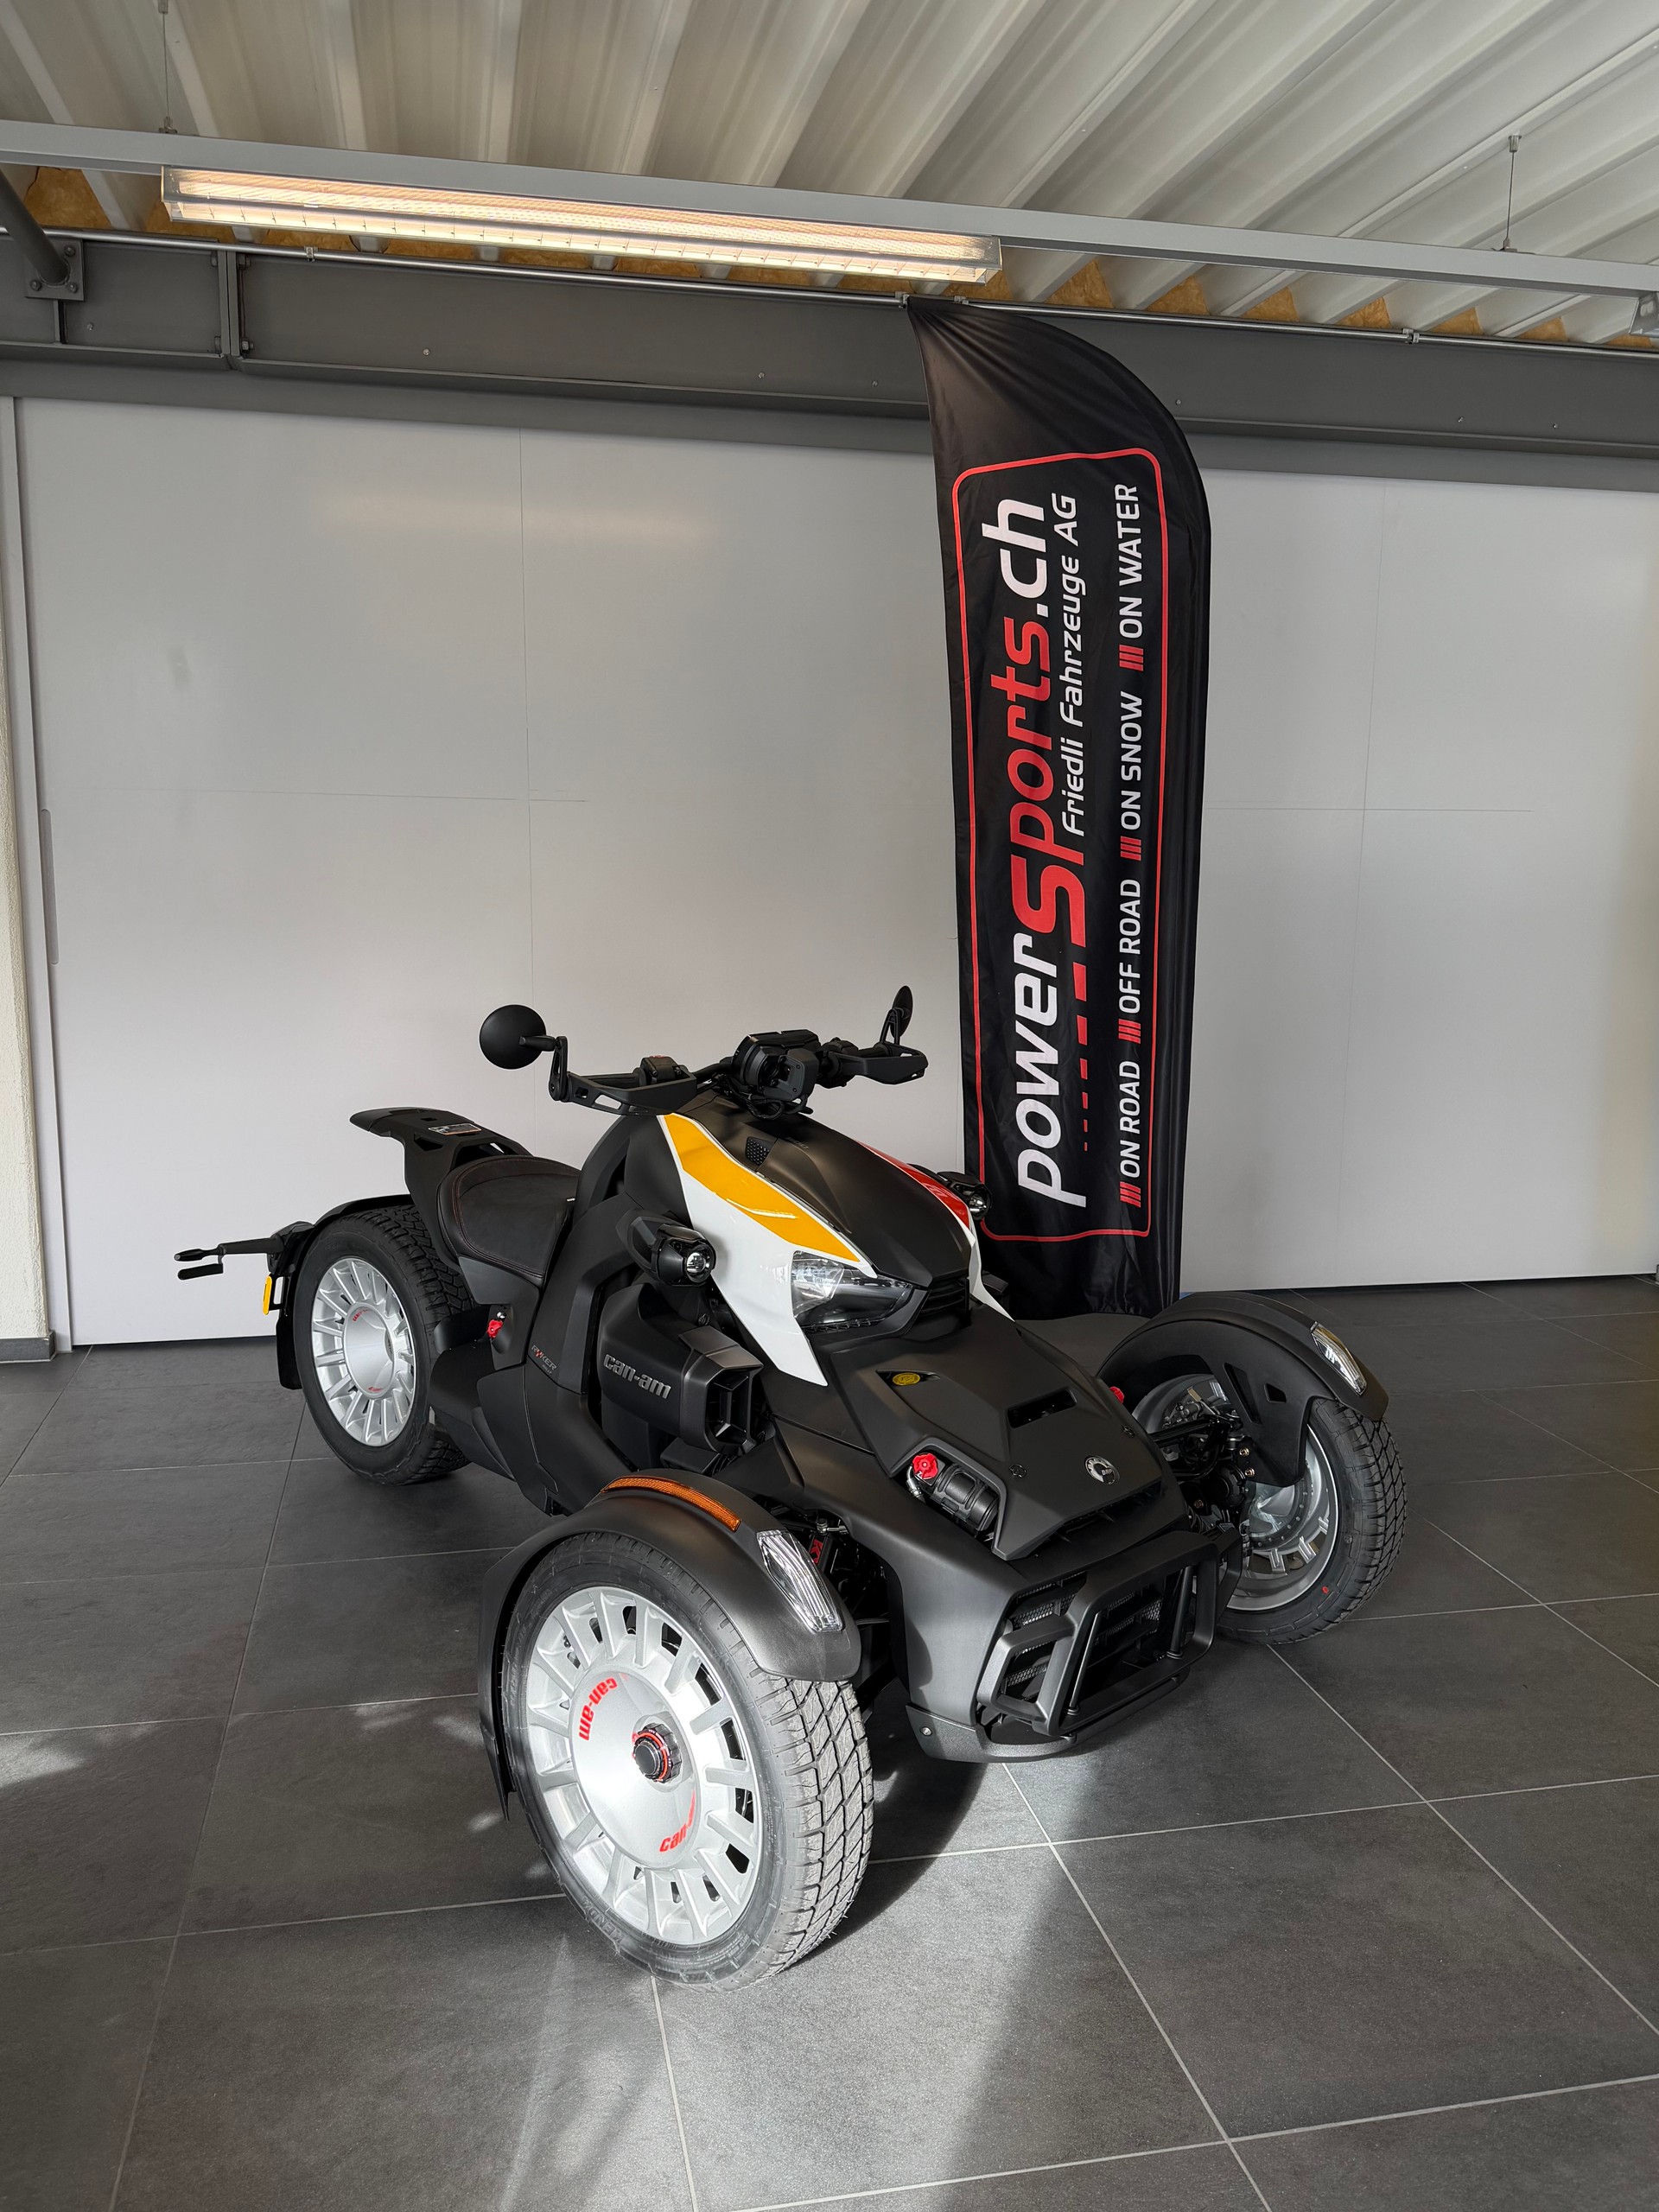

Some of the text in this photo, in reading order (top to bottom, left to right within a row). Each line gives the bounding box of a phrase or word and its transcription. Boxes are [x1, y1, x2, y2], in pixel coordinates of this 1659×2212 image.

[1052, 493, 1086, 836] Friedli Fahrzeuge AG
[1115, 484, 1142, 1178] ON ROAD OFF ROAD ON SNOW ON WATER
[531, 1344, 557, 1370] RYKER
[603, 1354, 671, 1399] can-am
[578, 1676, 619, 1741] can-am
